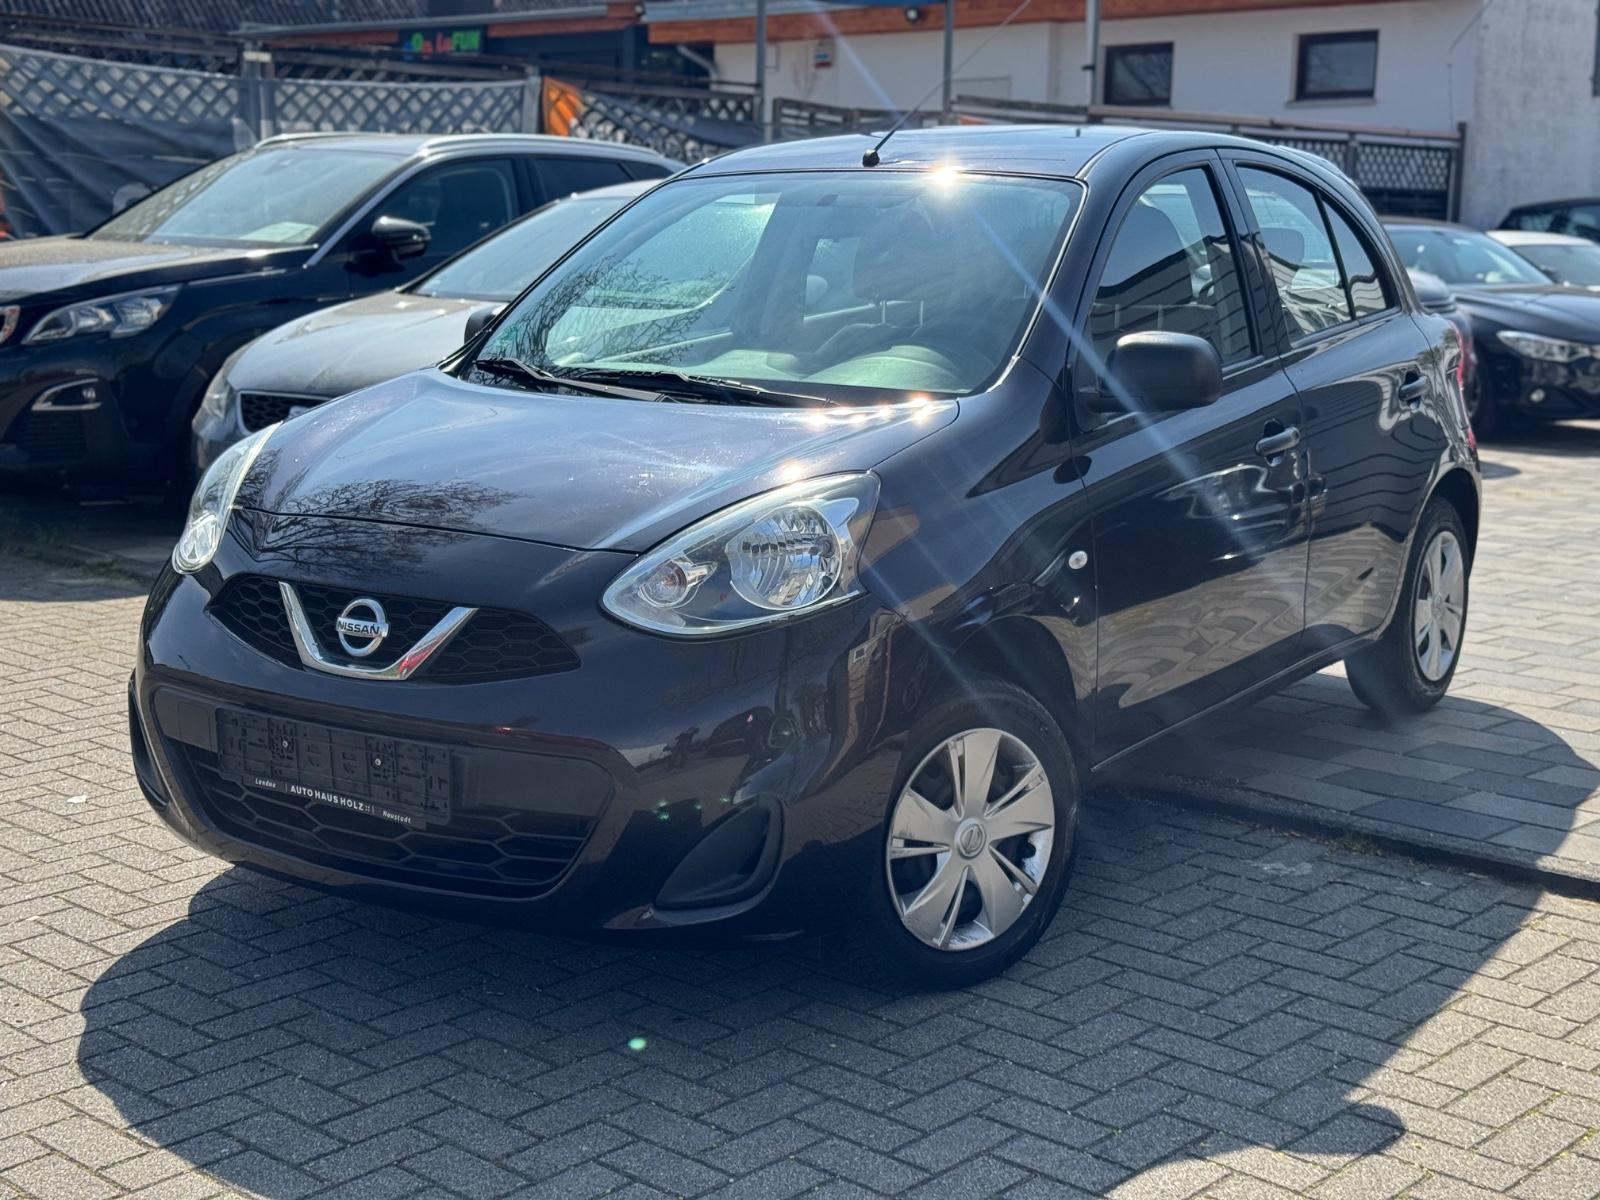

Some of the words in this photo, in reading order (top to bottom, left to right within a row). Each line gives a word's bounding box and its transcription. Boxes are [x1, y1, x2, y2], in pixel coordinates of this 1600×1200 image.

[337, 620, 380, 635] NISSAN
[290, 785, 314, 798] AUTO
[315, 790, 339, 804] HAUS
[340, 797, 364, 812] HOLZ
[382, 810, 412, 824] Neustadt
